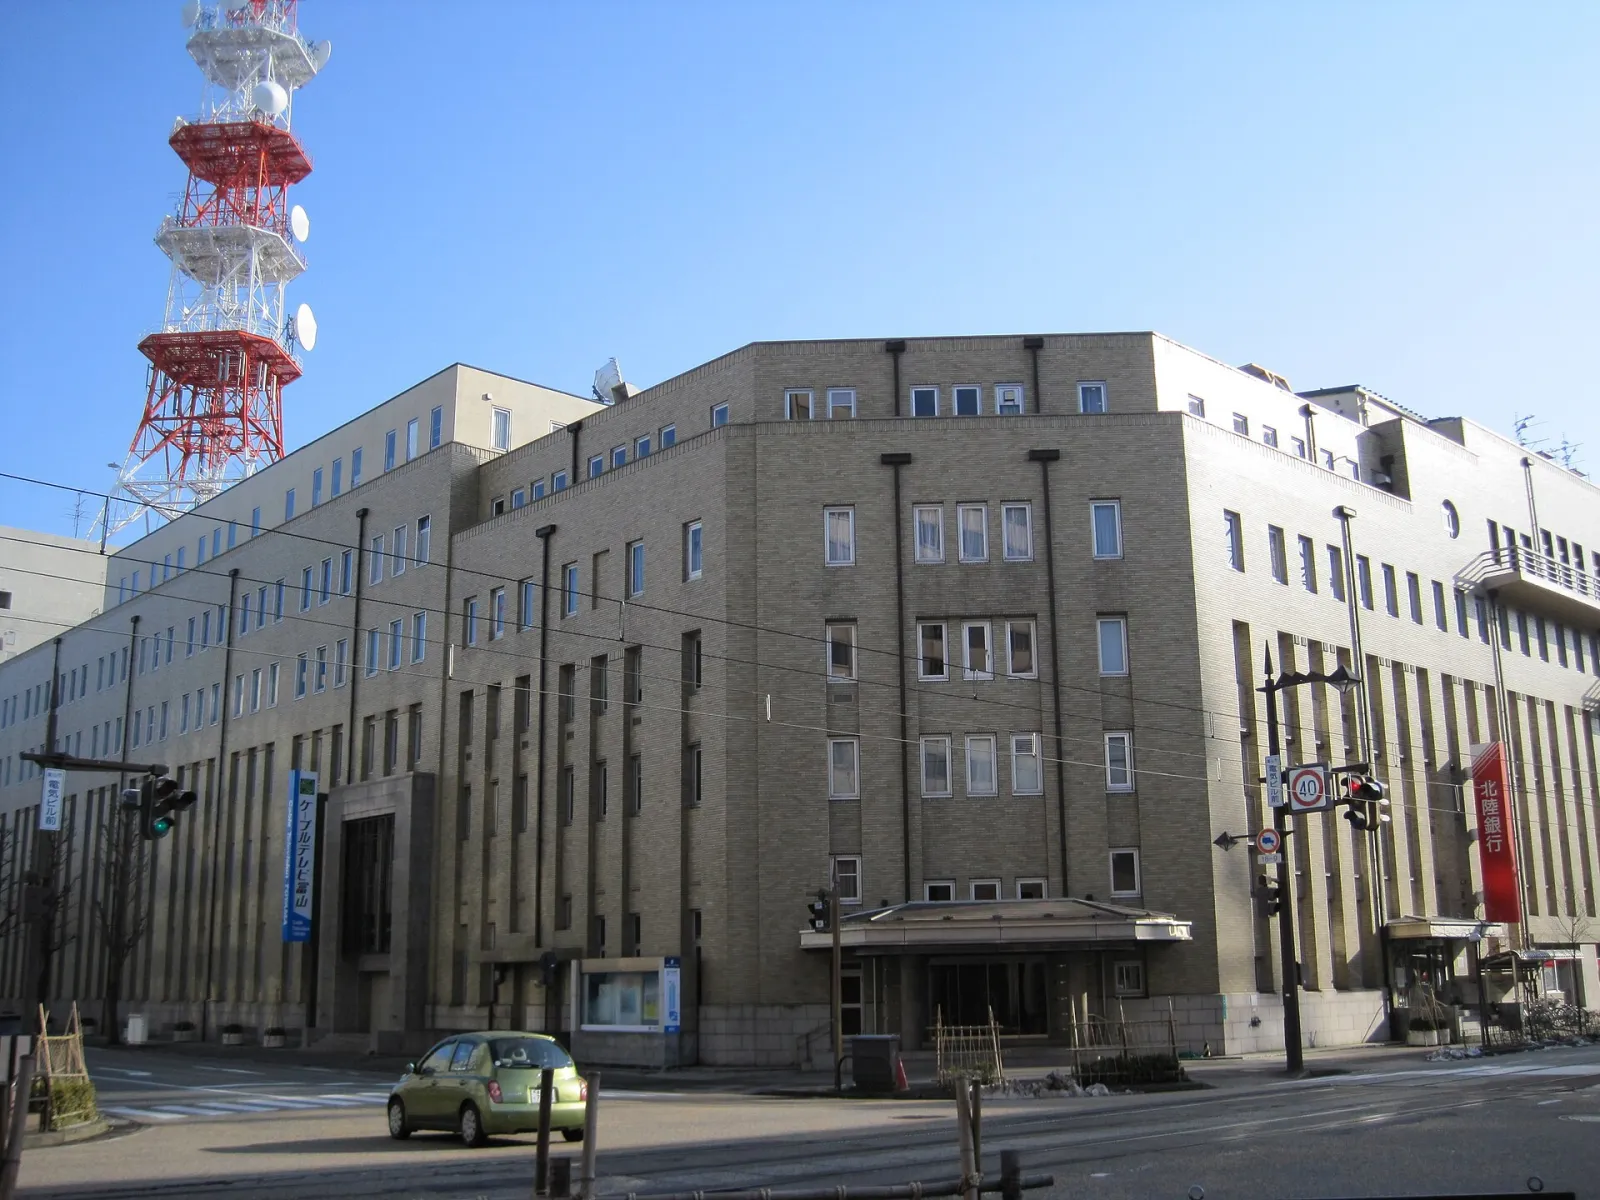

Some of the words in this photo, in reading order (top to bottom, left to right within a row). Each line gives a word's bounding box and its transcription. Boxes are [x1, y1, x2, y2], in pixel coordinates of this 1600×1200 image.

[46, 780, 60, 825] 電気ビル前
[1300, 780, 1316, 796] 40
[1481, 780, 1502, 852] 北陸銀行
[296, 800, 313, 908] ケーブルテレビ富山
